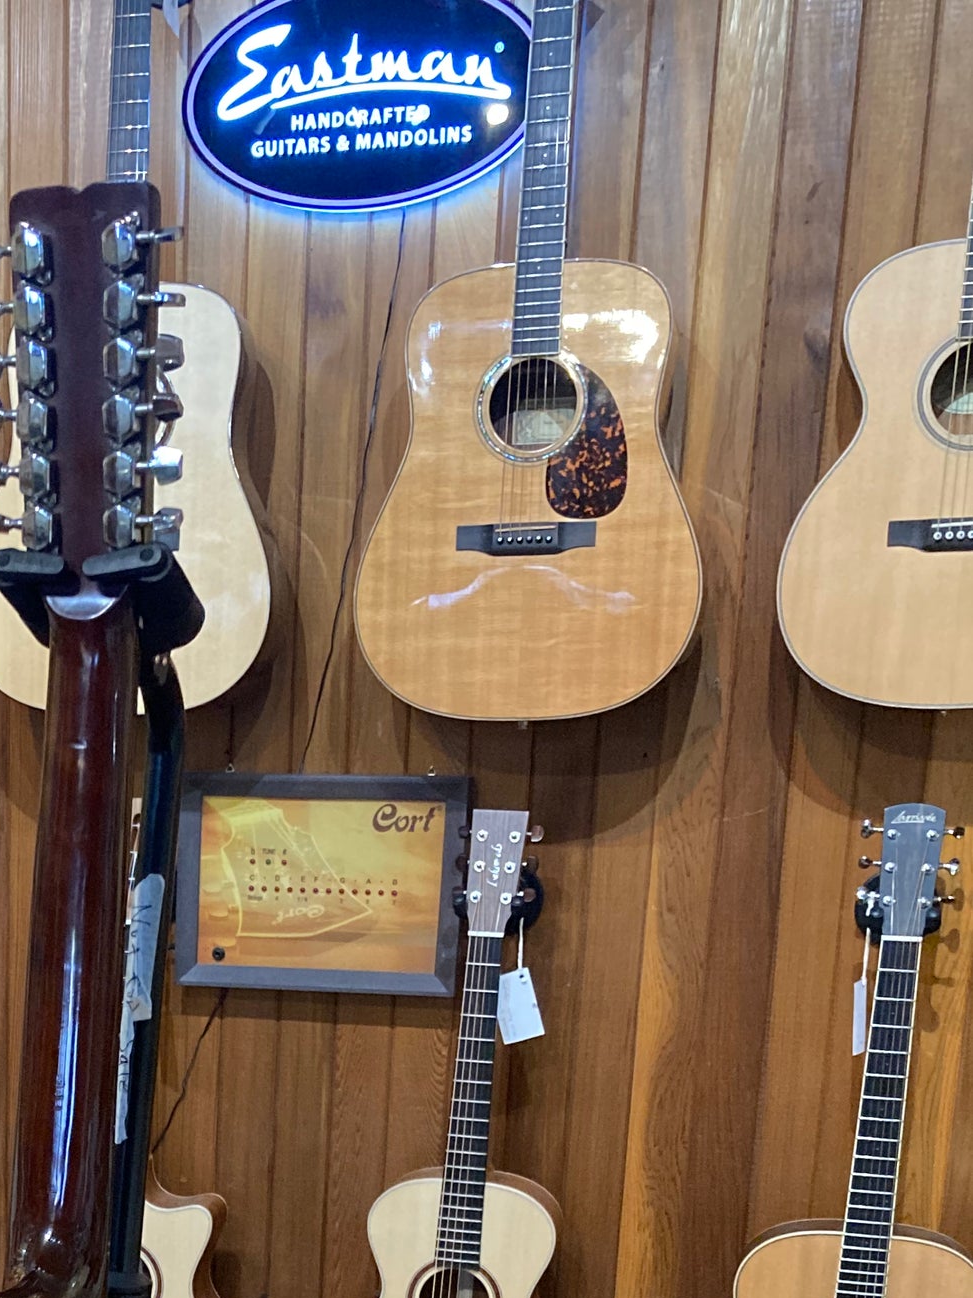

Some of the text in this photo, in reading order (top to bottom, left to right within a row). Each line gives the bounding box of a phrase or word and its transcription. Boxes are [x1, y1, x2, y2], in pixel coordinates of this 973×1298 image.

[217, 23, 512, 121] Eastman
[250, 125, 472, 158] GUITARS & MANDOLINS
[372, 803, 436, 833] Cort
